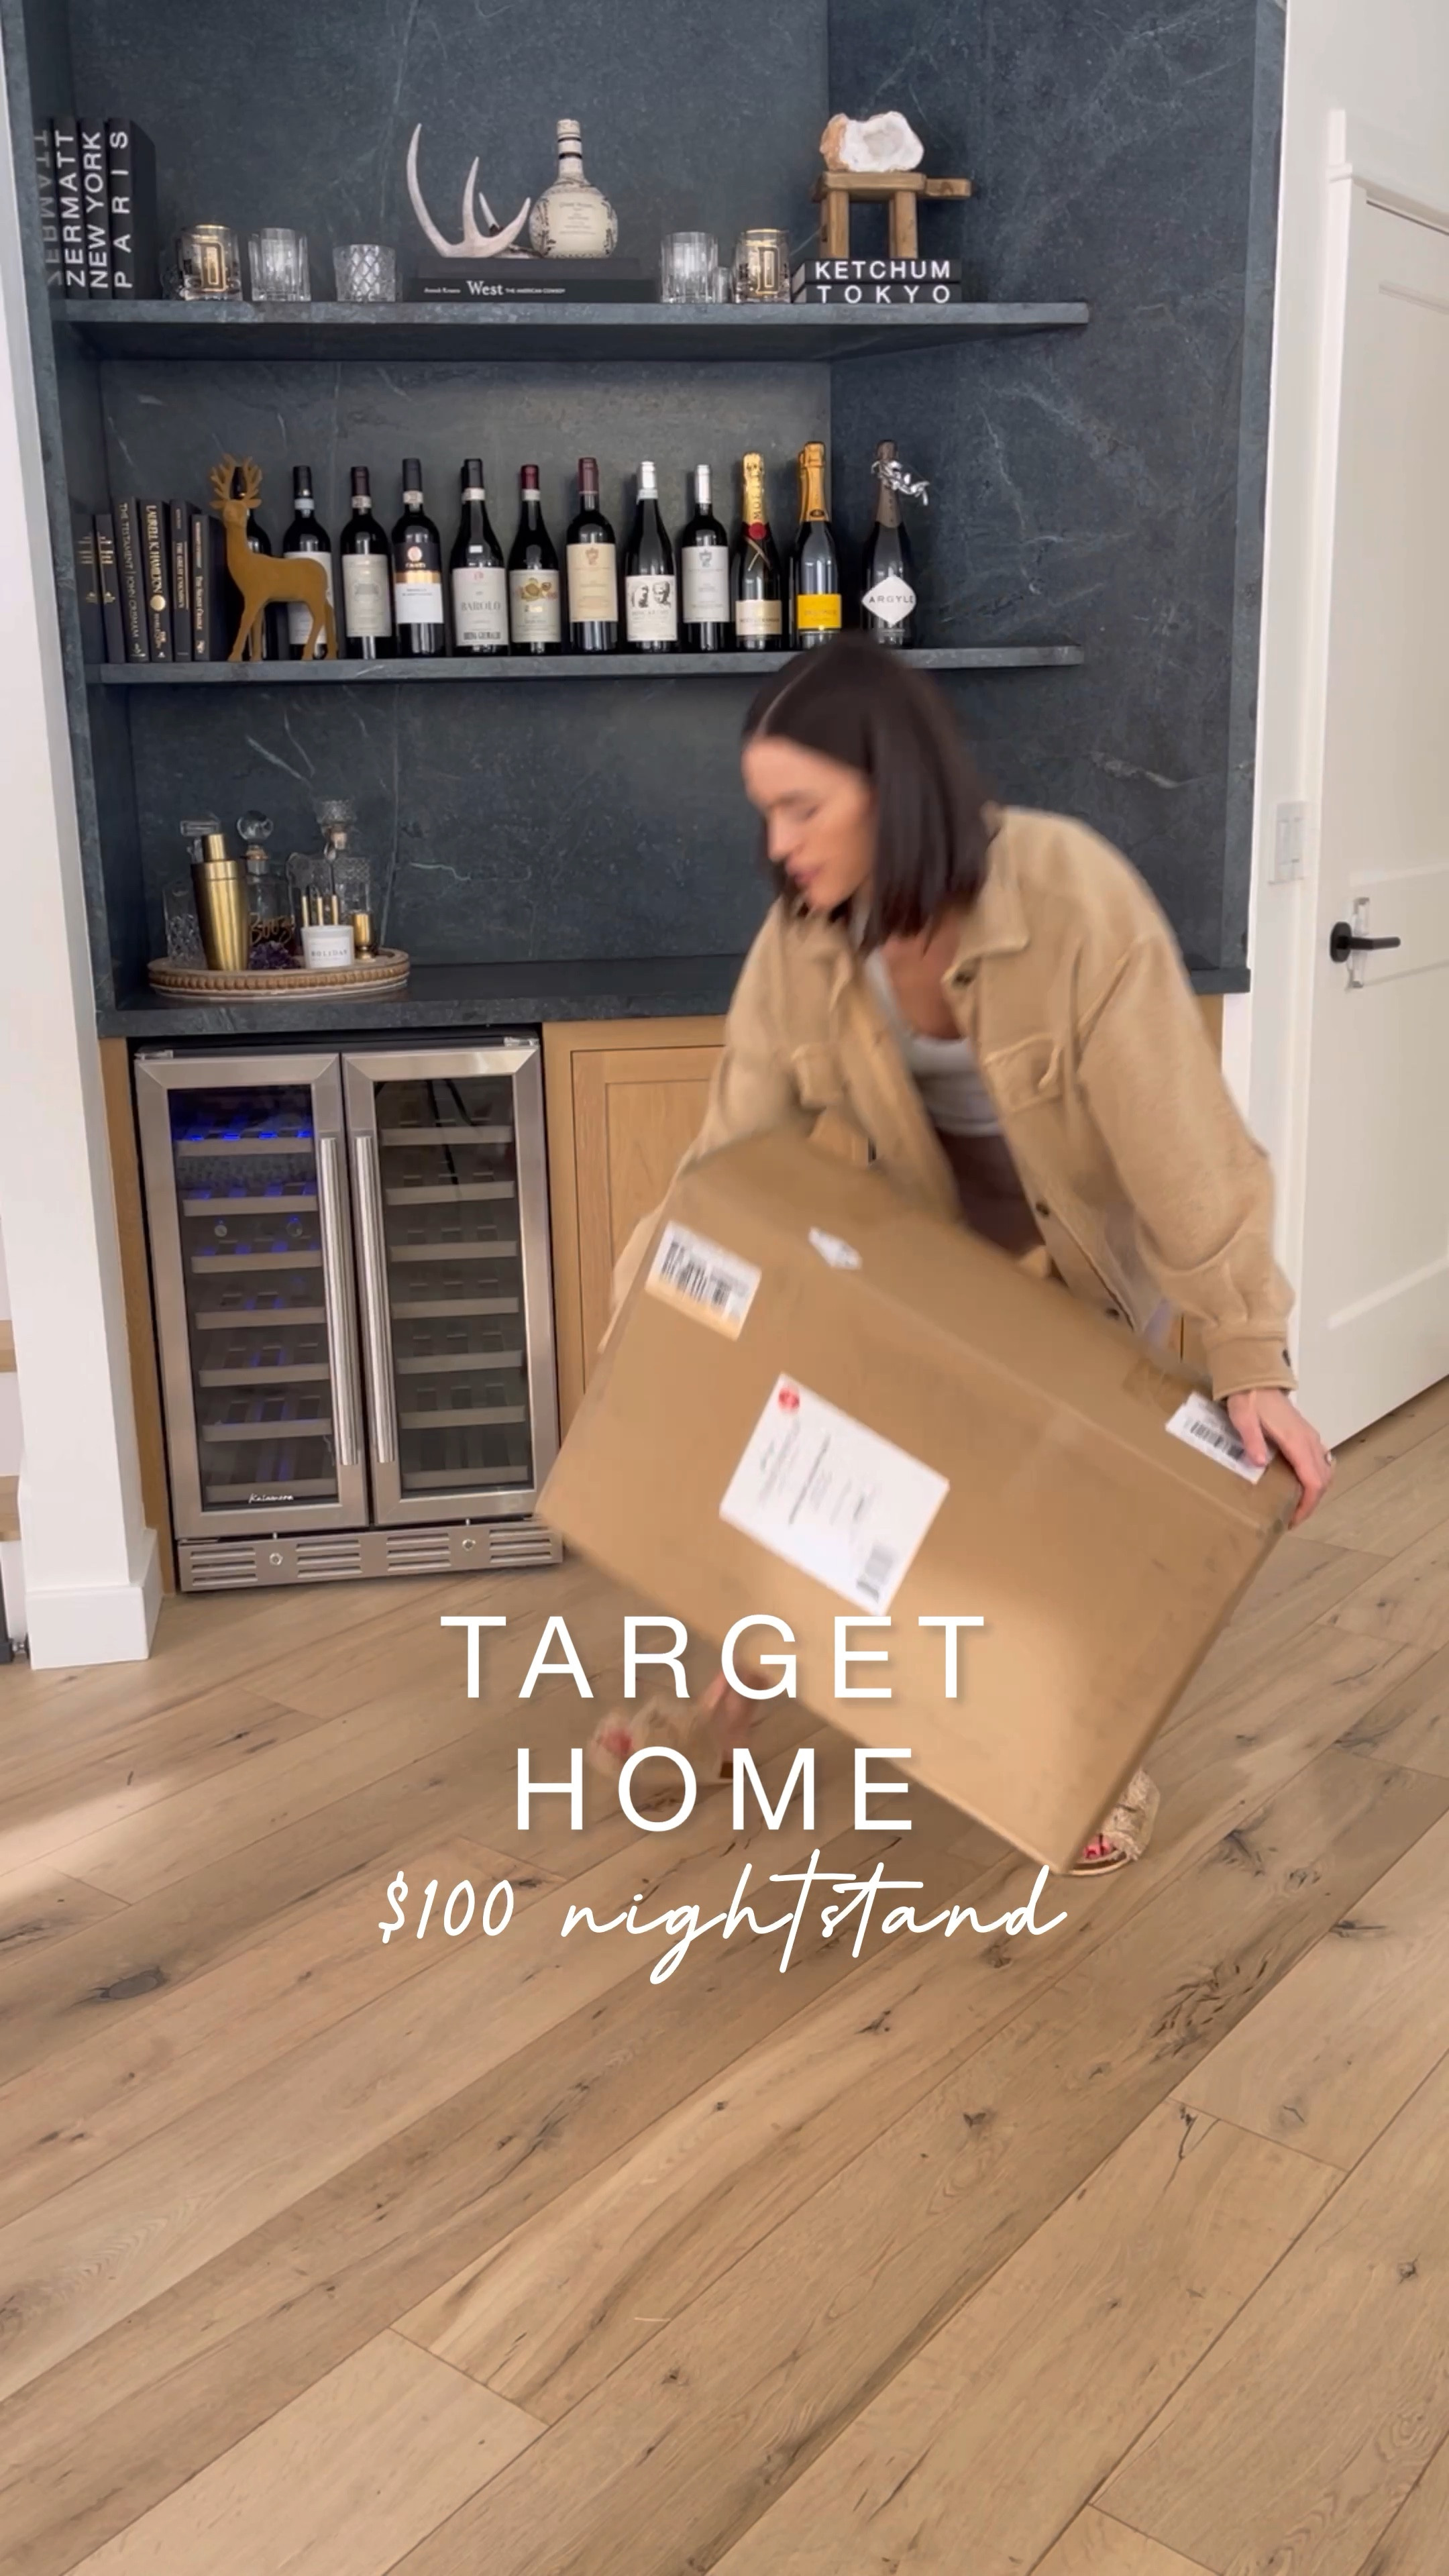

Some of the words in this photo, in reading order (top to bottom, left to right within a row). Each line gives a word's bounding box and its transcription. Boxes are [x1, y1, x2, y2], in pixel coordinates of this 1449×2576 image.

[83, 131, 105, 213] YORK
[54, 130, 86, 287] ZERMATT
[109, 131, 133, 288] PARIS
[88, 224, 109, 288] NEW
[815, 260, 951, 280] KETCHUM
[466, 280, 503, 295] West
[816, 285, 951, 304] TOKYO
[462, 600, 500, 611] BAROLO
[869, 595, 914, 603] ARGYLE
